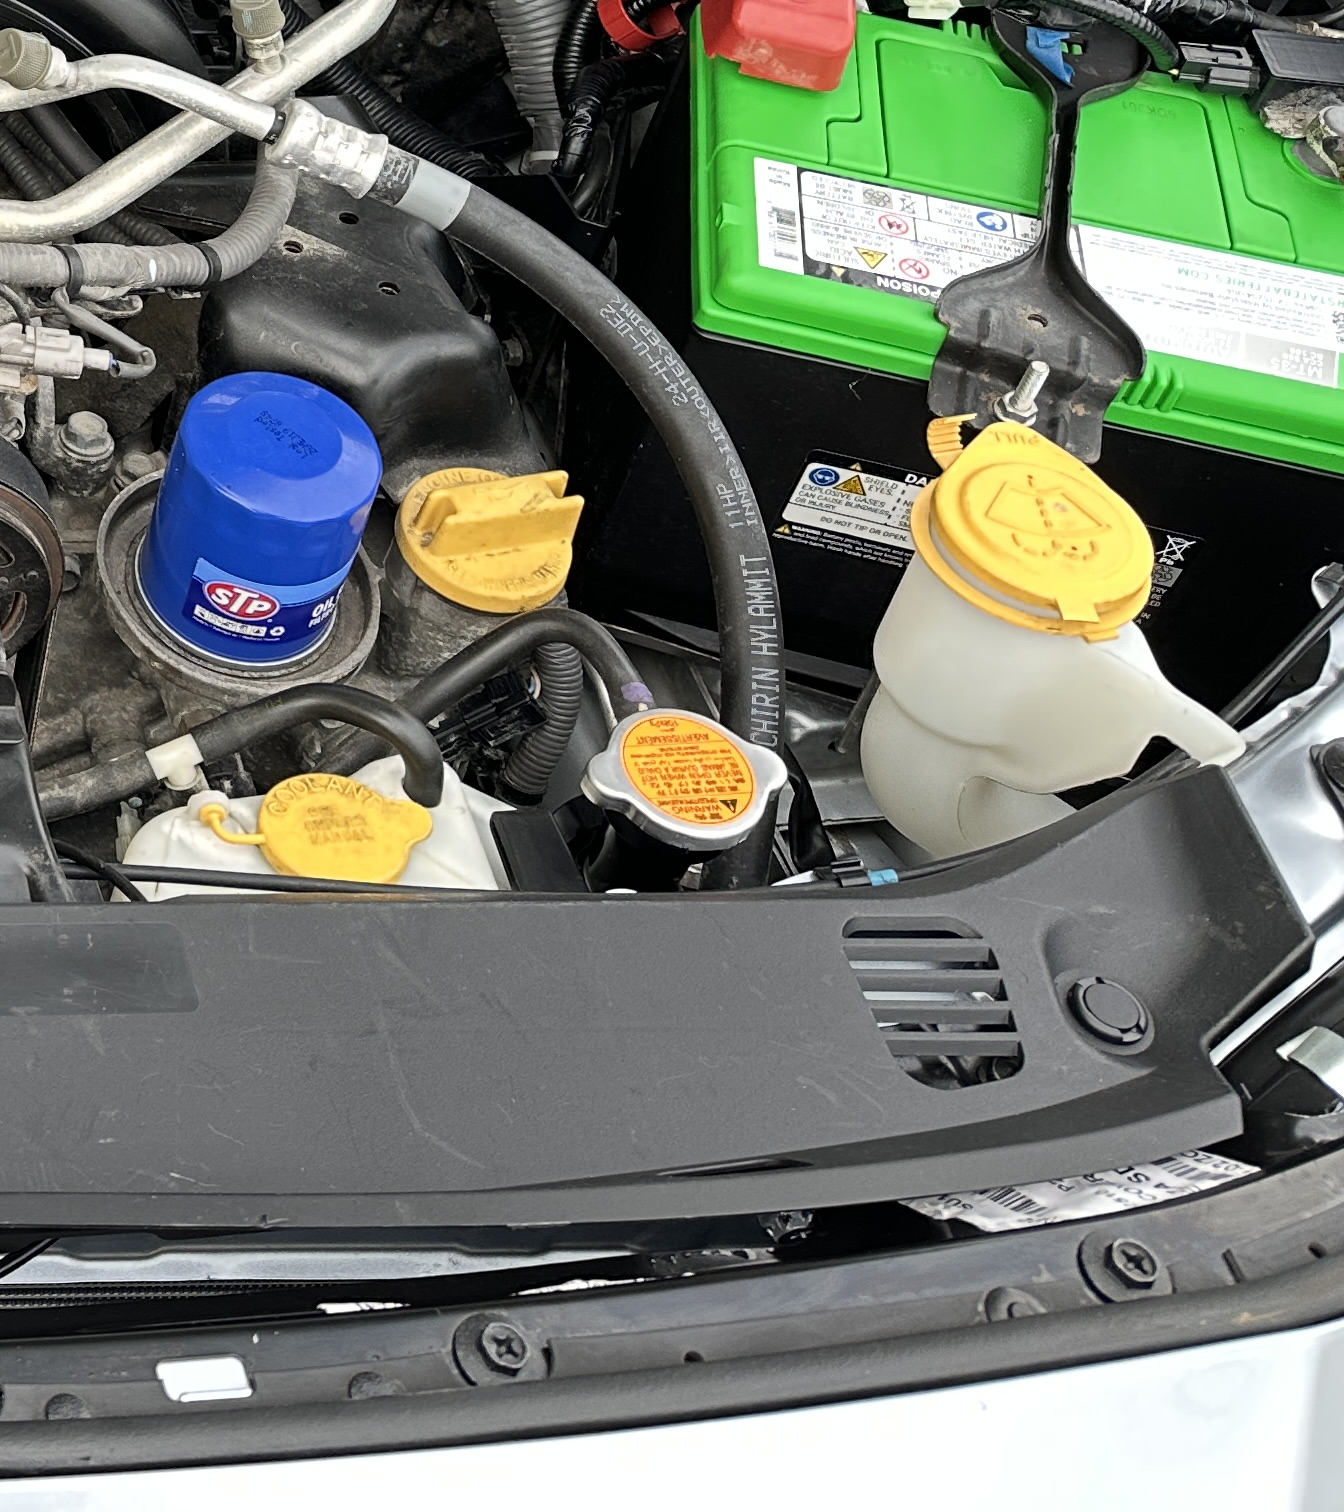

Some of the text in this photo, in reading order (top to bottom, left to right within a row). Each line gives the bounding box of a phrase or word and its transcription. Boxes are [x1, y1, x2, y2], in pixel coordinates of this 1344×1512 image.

[876, 276, 942, 299] POISON
[1270, 357, 1323, 379] MT-35
[863, 476, 899, 490] SHIELD
[834, 519, 853, 529] NOT
[854, 523, 869, 532] TIP
[210, 587, 272, 615] STP
[266, 777, 384, 816] COOLANT
